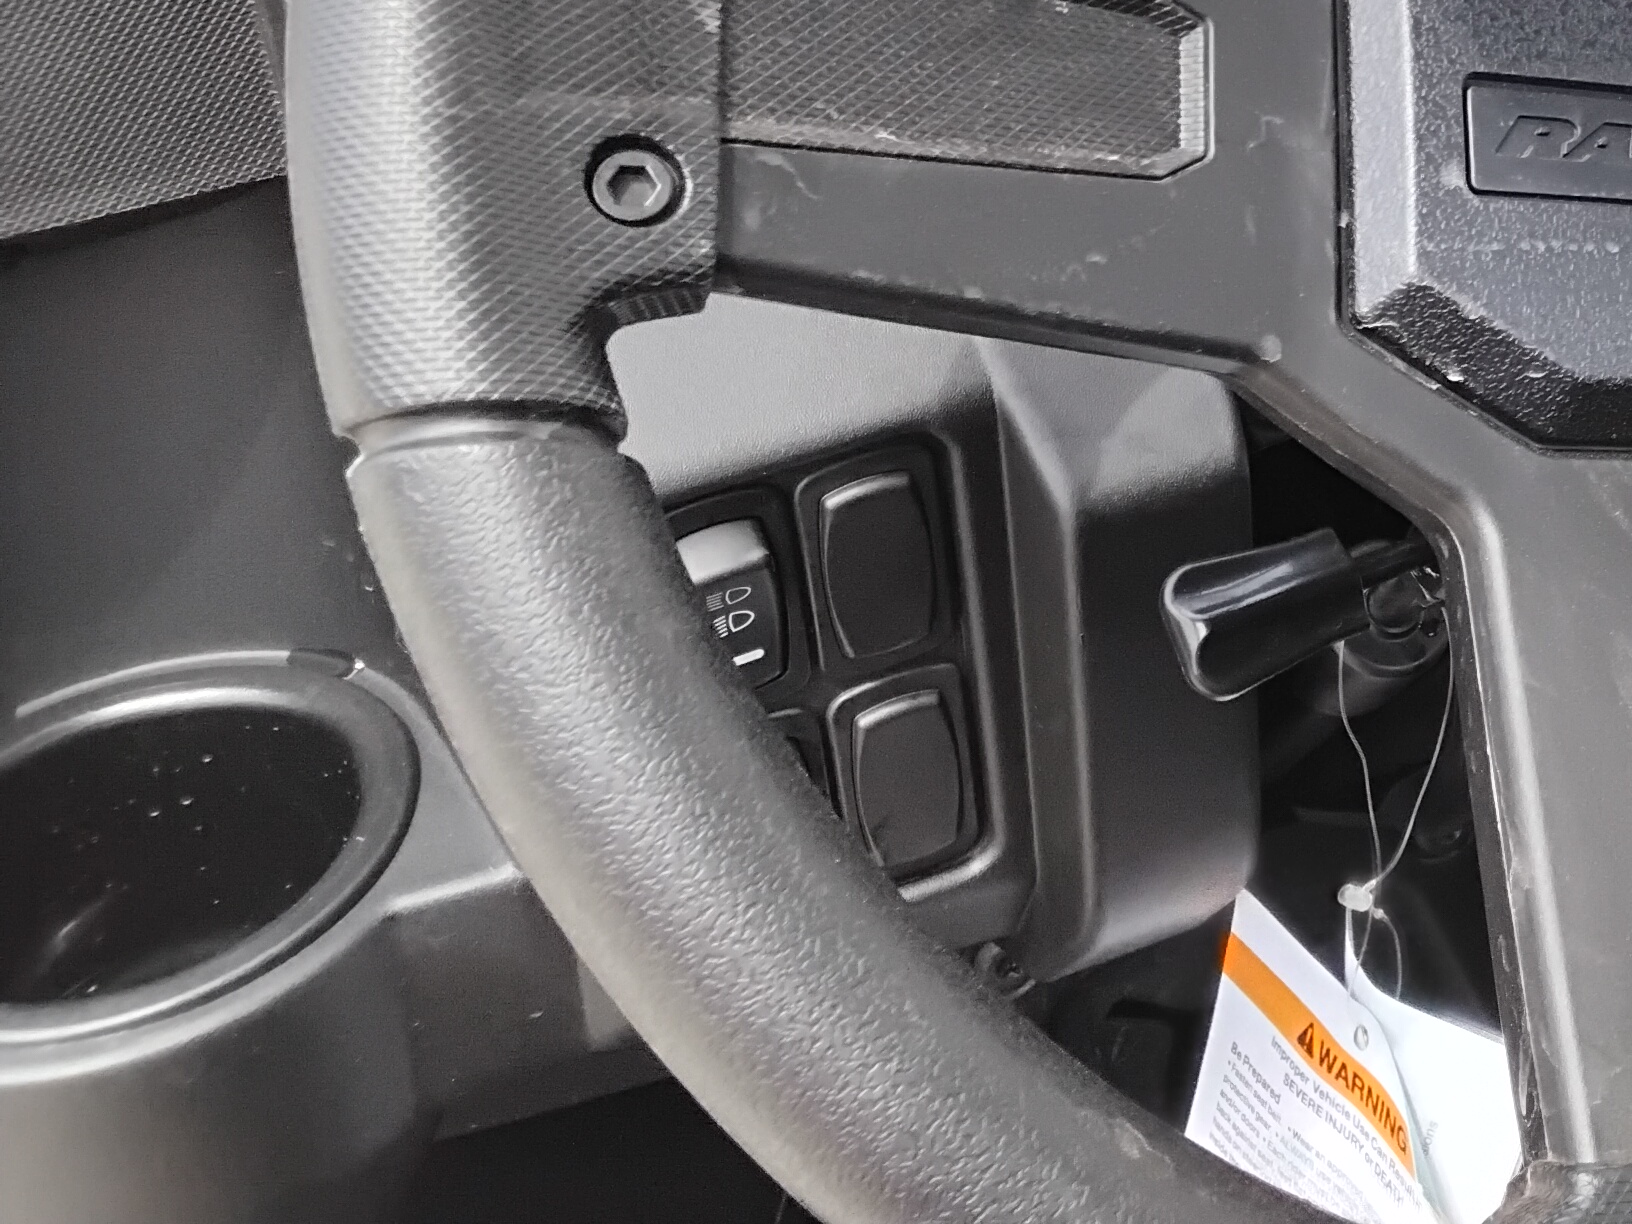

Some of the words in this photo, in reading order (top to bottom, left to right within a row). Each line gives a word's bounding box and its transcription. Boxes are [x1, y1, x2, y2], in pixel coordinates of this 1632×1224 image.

[1230, 1041, 1242, 1061] Be
[1242, 1054, 1281, 1105] Prepared
[1271, 1035, 1310, 1085] Improper
[1313, 1079, 1351, 1121] Vehicle
[1353, 1114, 1371, 1142] Use
[1371, 1136, 1388, 1165] Can
[1283, 1073, 1323, 1118] SEVERE
[1325, 1110, 1364, 1153] INJURY
[1364, 1152, 1374, 1167] or
[1319, 1039, 1409, 1156] WARNING
